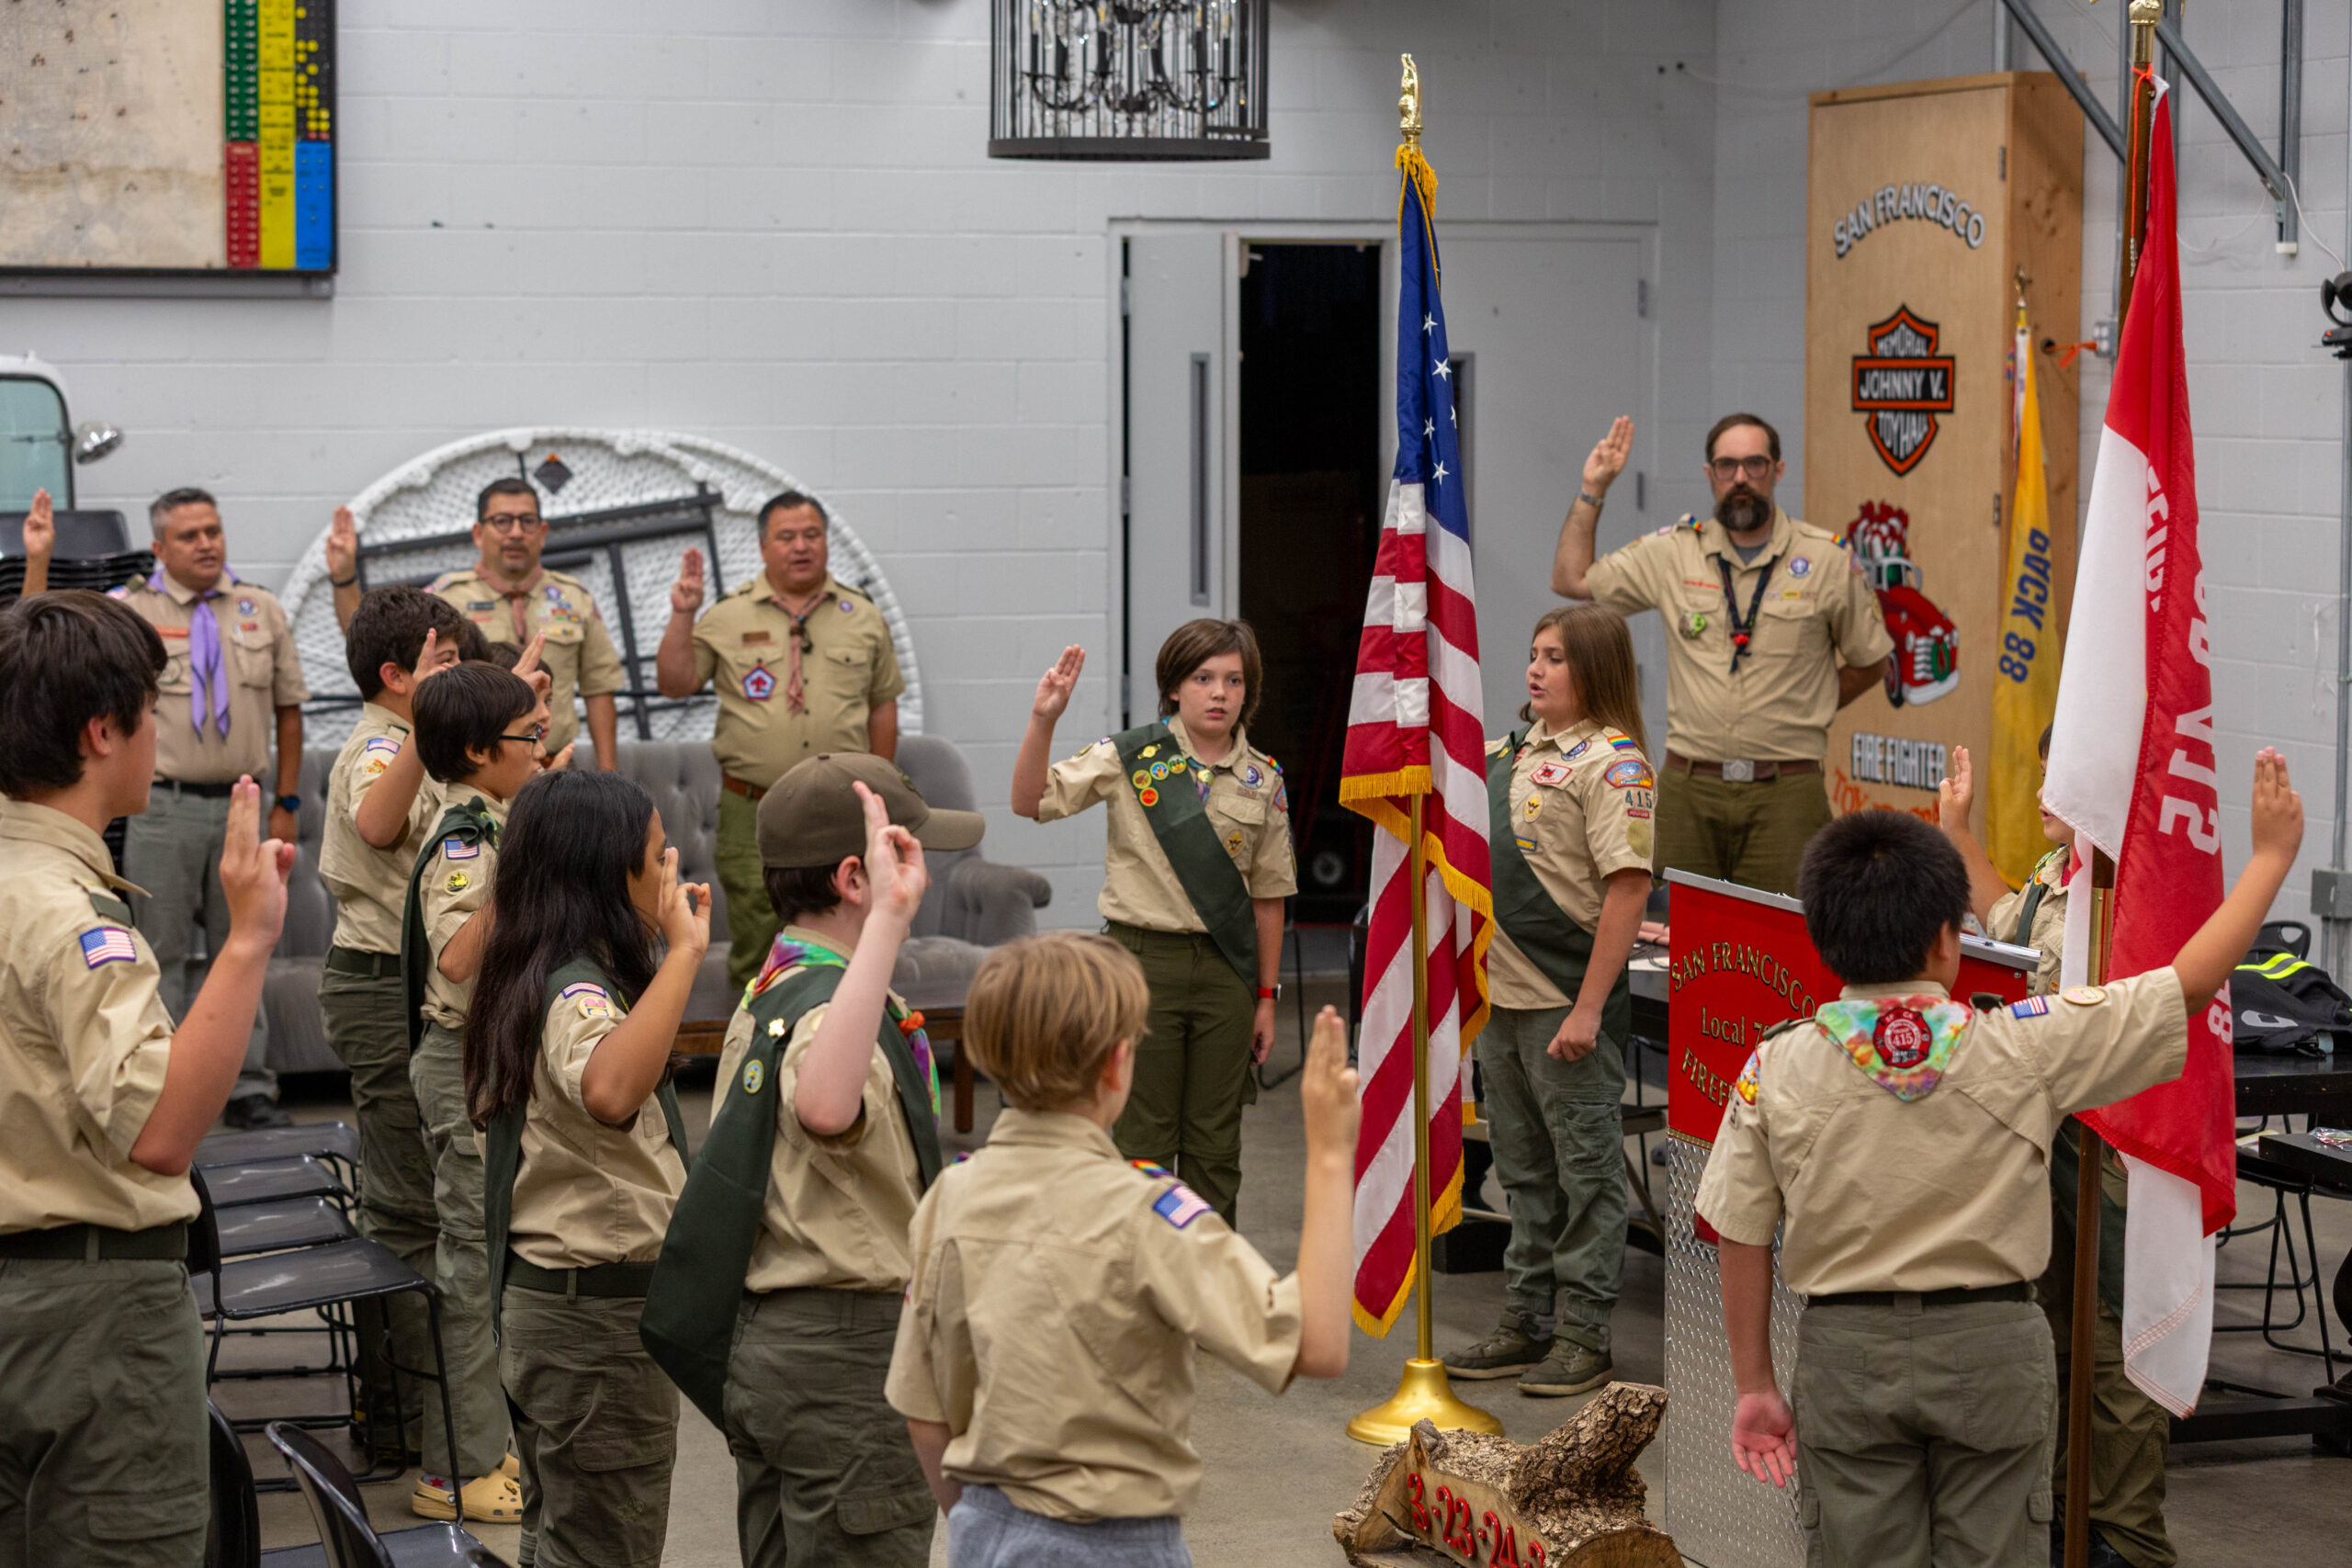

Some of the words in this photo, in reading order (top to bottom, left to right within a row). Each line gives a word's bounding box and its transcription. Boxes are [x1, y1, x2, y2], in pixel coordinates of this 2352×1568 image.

[1834, 198, 1872, 259] SAN
[1874, 183, 1985, 250] FRANCISCO
[1877, 322, 1928, 357] MEMORIAL
[1860, 369, 1925, 400] JOHNNY
[1929, 369, 1945, 400] V.
[1624, 790, 1653, 808] 415
[1670, 946, 1705, 992] SAN
[1712, 941, 1816, 1020] FRANCISCO
[1702, 1005, 1746, 1047] Local
[1893, 1032, 1914, 1047] 415
